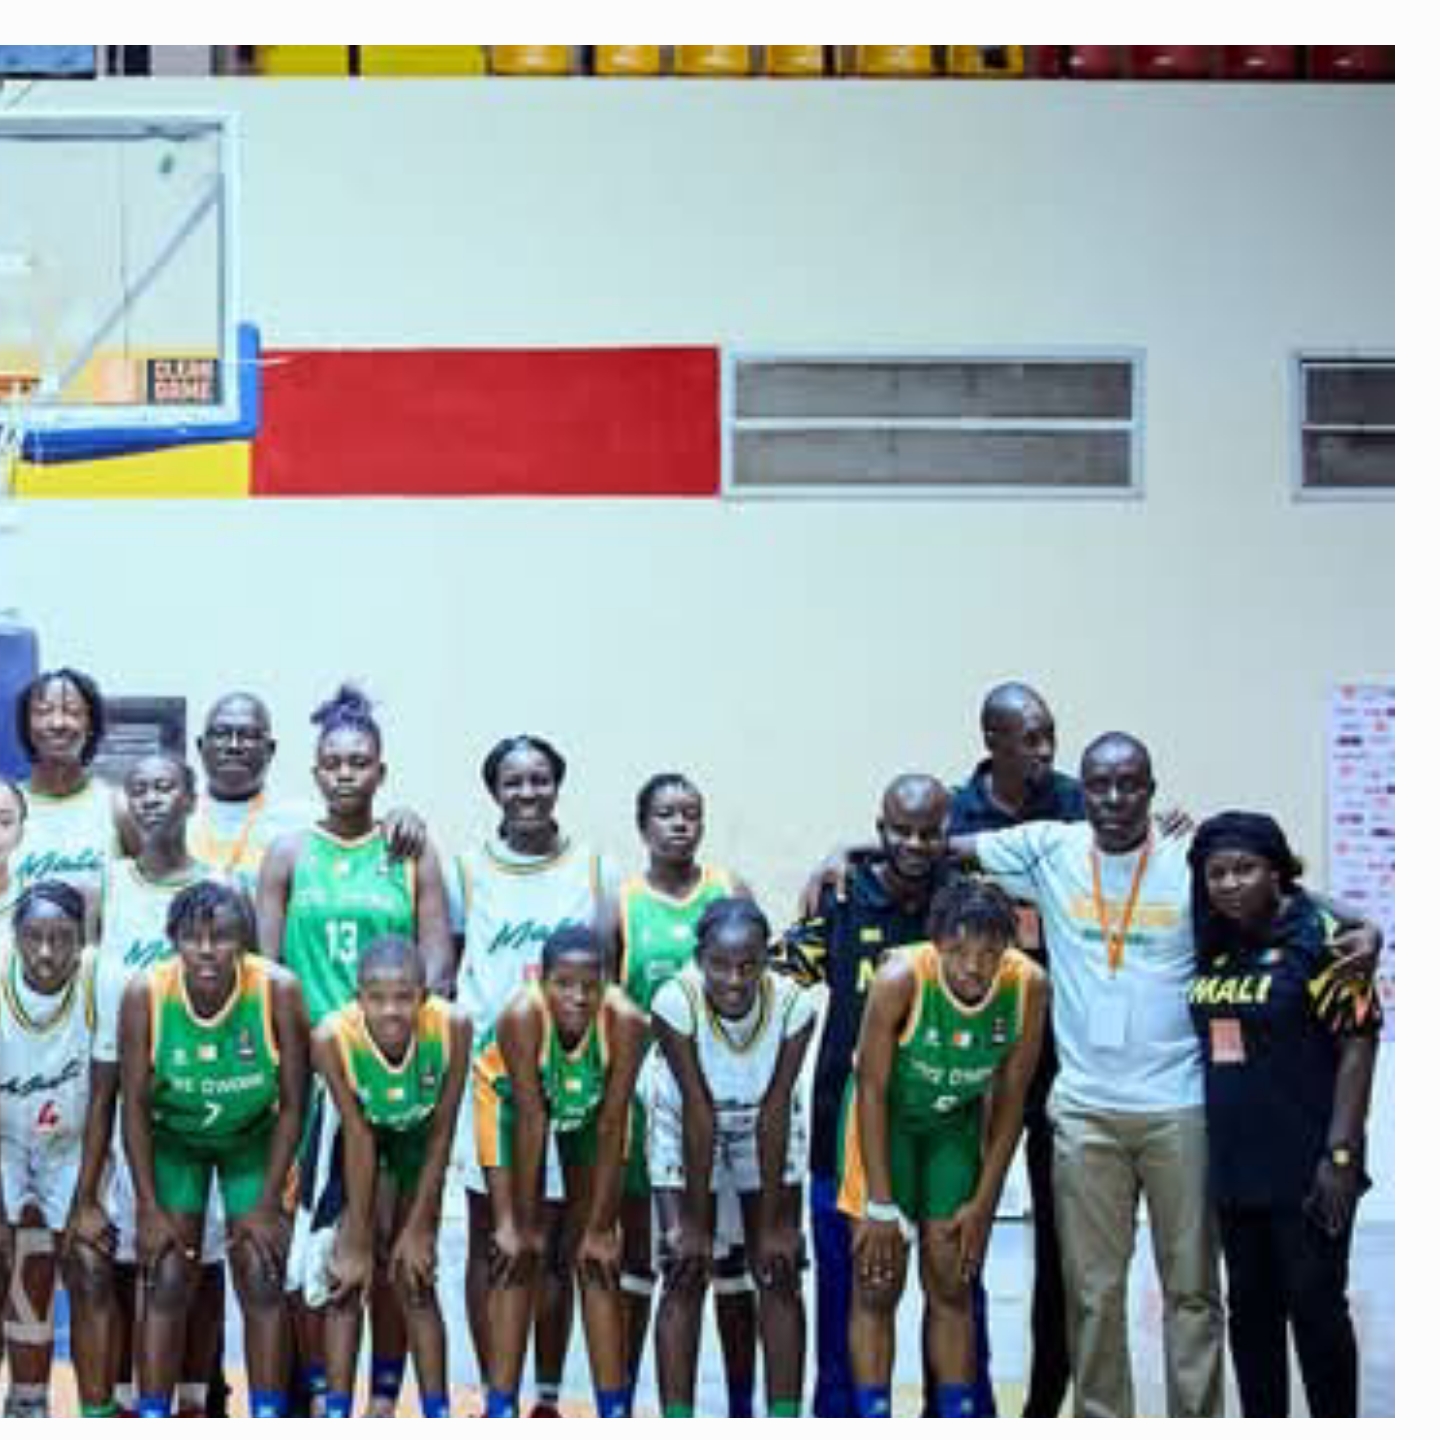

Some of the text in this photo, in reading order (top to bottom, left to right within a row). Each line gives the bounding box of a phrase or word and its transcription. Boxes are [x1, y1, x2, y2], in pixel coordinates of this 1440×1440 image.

[323, 918, 357, 960] 13
[1188, 974, 1272, 1005] MALI
[36, 1099, 60, 1127] 4
[201, 1102, 224, 1128] 7
